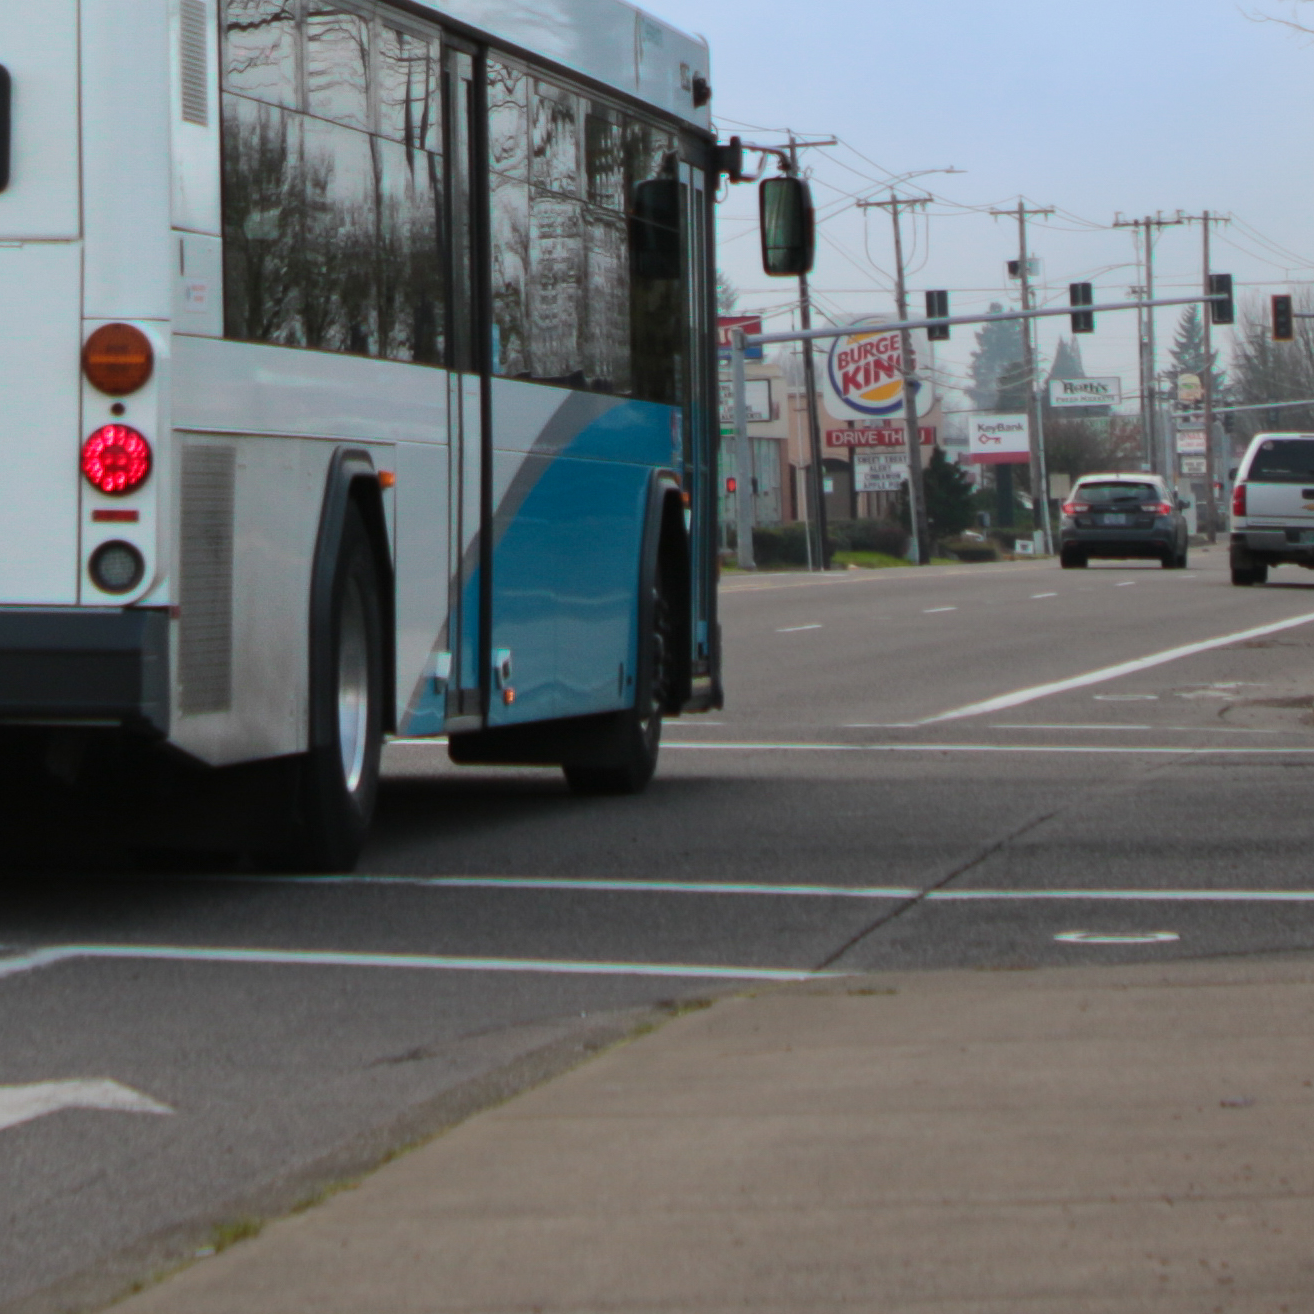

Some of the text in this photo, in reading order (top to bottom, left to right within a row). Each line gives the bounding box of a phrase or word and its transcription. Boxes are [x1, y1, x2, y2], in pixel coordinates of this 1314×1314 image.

[838, 334, 916, 371] BURGE
[977, 423, 1024, 434] KeyBank
[832, 429, 925, 445] DRIVE THU
